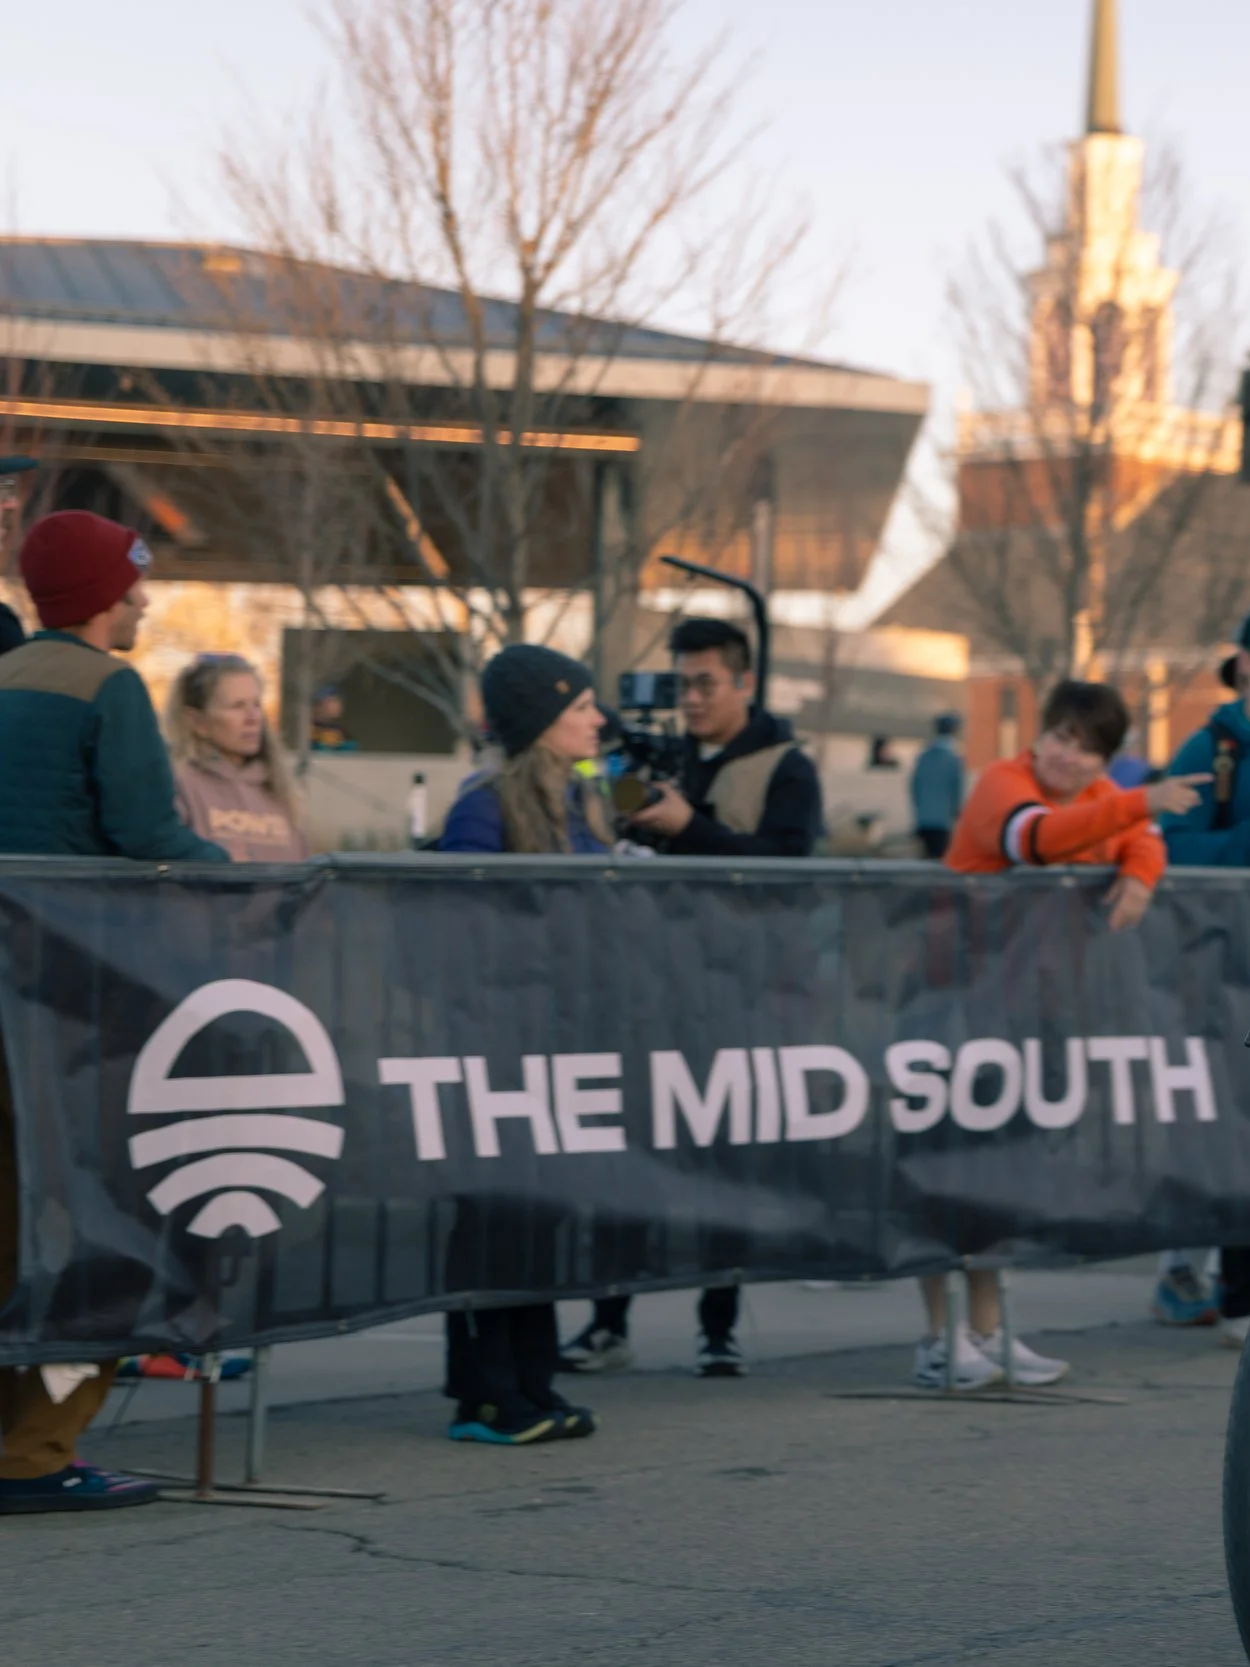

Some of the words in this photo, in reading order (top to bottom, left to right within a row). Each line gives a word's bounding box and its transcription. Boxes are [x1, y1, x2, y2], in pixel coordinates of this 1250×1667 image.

[377, 1052, 627, 1161] THE
[649, 1044, 870, 1149] MID
[884, 1036, 1217, 1133] SOUTH
